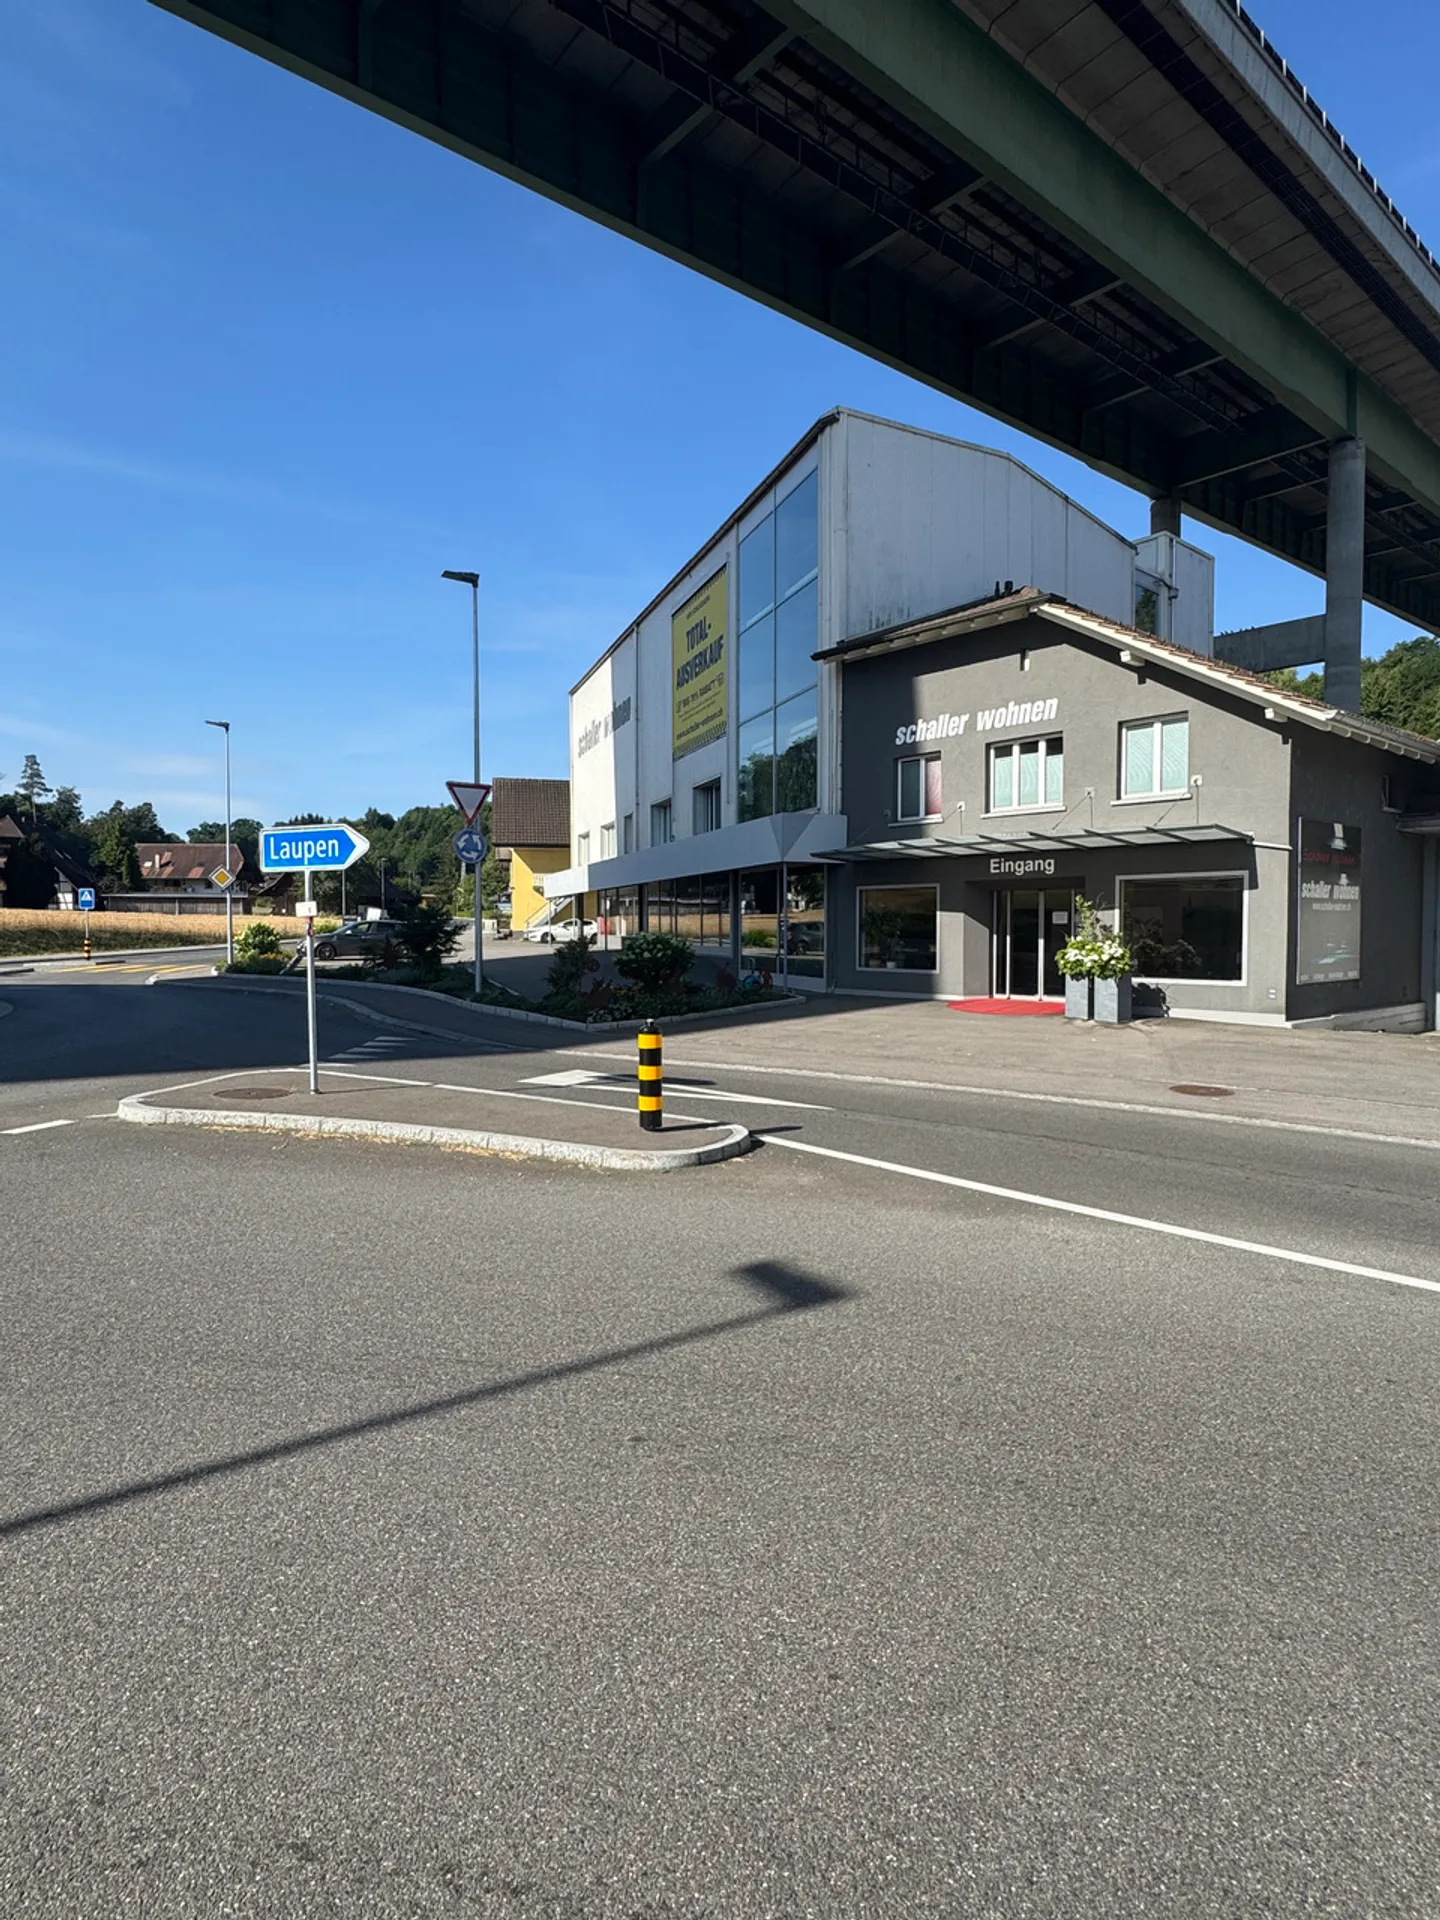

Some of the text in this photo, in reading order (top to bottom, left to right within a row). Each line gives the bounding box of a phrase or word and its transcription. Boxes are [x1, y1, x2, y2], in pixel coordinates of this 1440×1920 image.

[686, 615, 712, 653] TOTAL-
[676, 634, 724, 691] AUSVERKAUF
[895, 698, 1058, 745] schaller wohnen
[270, 837, 339, 865] Laupen
[990, 858, 1055, 876] Eingang
[1302, 880, 1331, 898] schaller
